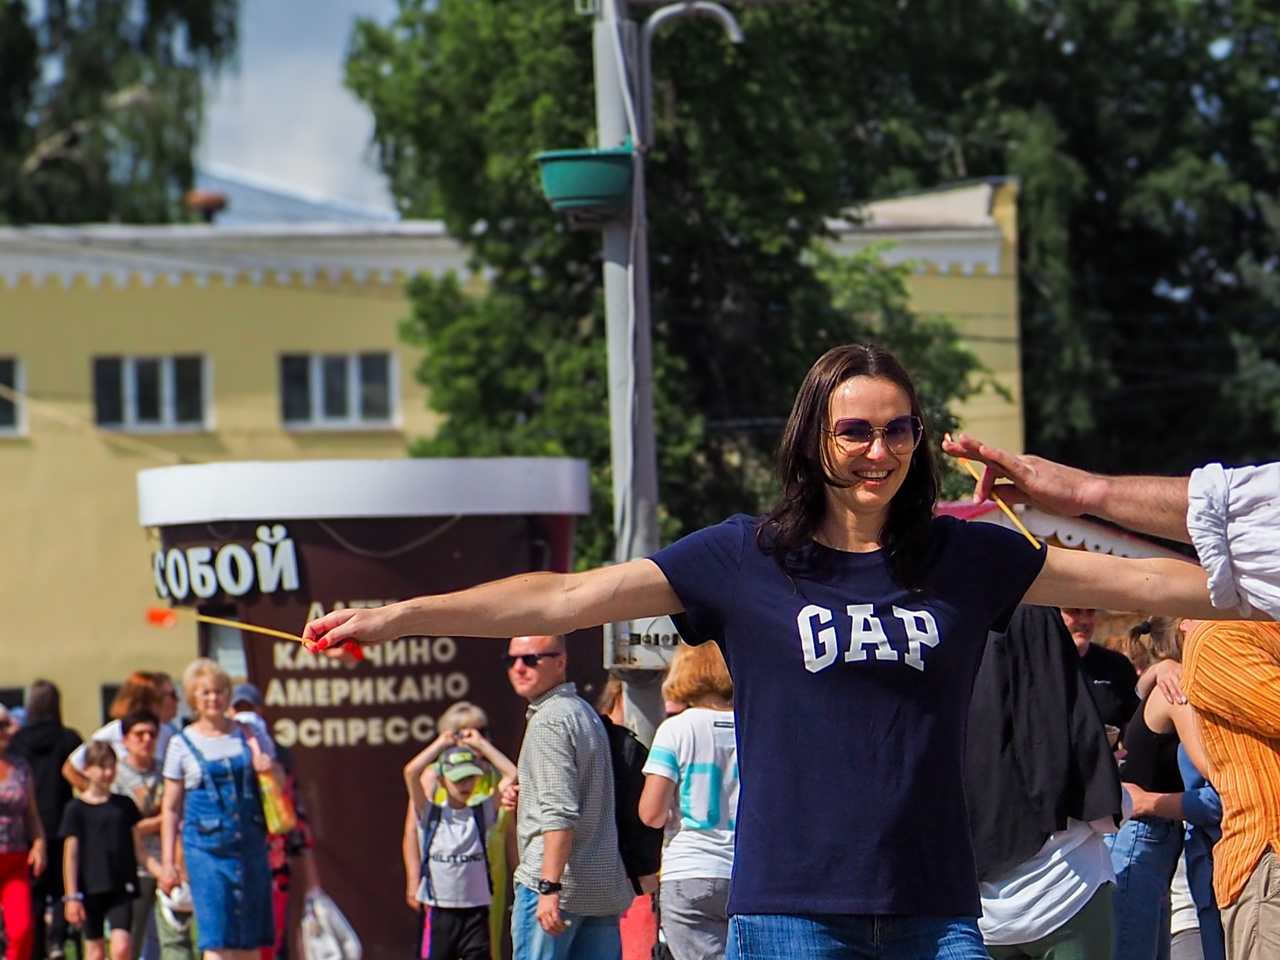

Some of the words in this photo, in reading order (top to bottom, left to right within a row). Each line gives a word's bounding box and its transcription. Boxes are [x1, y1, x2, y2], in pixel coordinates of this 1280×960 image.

[154, 524, 299, 599] СОБОЙ
[272, 637, 457, 670] КАЧИНО
[797, 604, 940, 673] GAP
[264, 672, 469, 706] АМЕРИКАНО
[273, 714, 438, 748] ЭСПРЕСС
